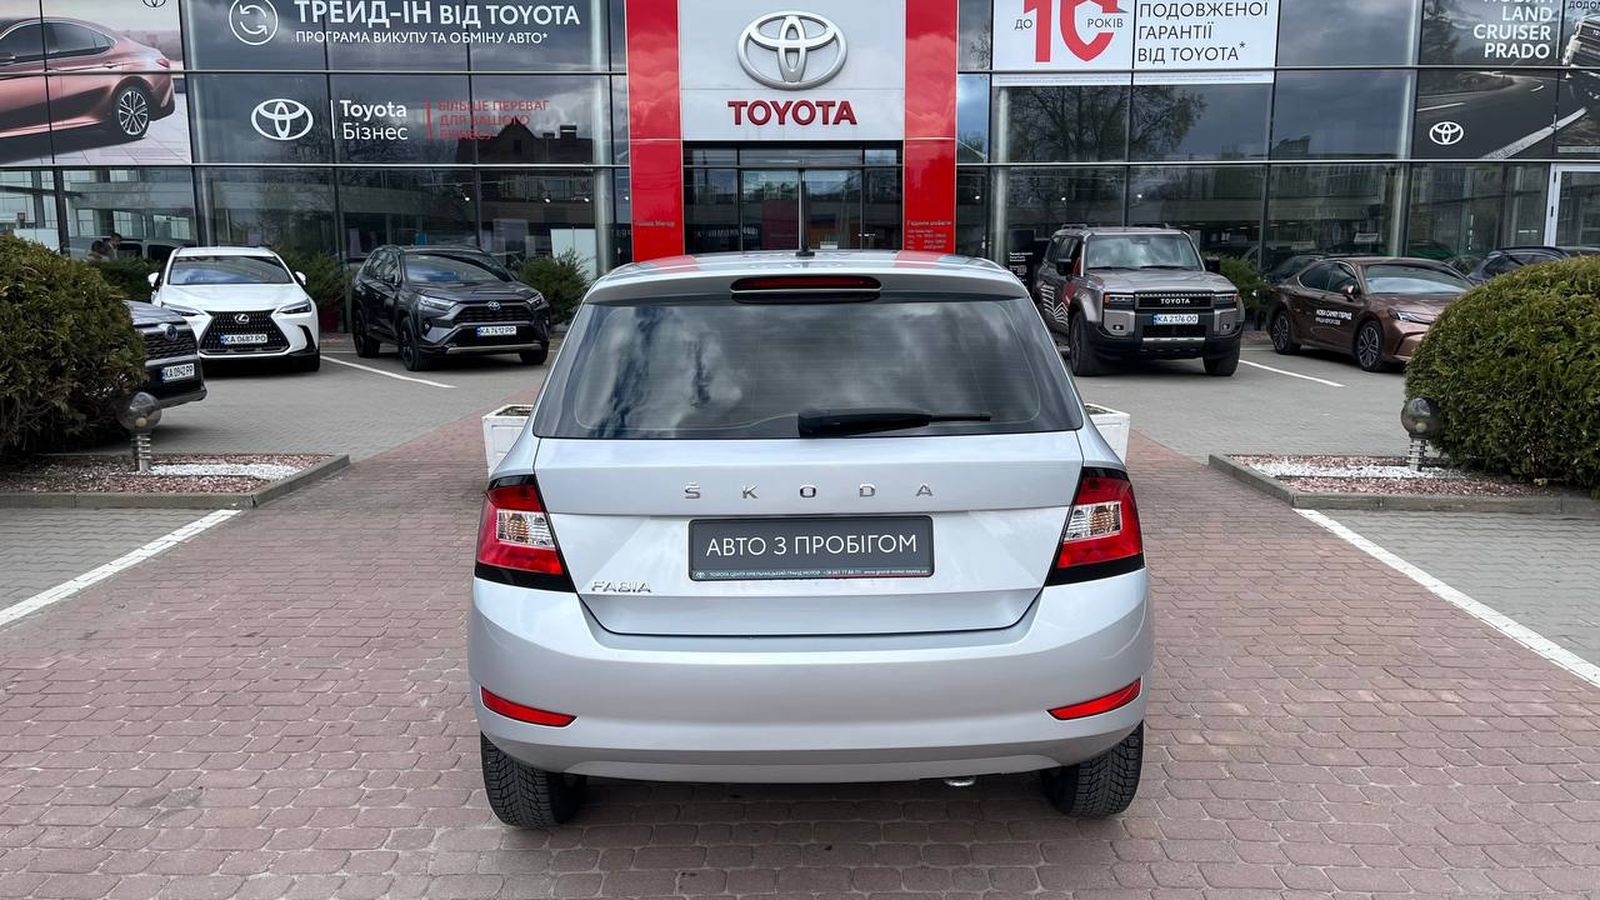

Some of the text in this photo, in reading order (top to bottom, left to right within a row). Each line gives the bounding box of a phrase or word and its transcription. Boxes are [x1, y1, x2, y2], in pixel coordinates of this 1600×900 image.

[440, 6, 481, 28] ВІД
[488, 5, 580, 25] TOYOTA
[1502, 6, 1552, 21] LAND
[1014, 19, 1033, 31] ДО
[1087, 18, 1124, 29] РОКІВ
[1138, 21, 1214, 40] ГАРАНТІЇ
[1473, 24, 1551, 40] CRUISER
[296, 31, 370, 44] ПРОГРАМА
[373, 32, 429, 44] ВИКУПУ
[431, 32, 447, 43] ТА
[450, 32, 504, 44] ОБМІНУ
[1137, 47, 1166, 64] ВІД
[1484, 42, 1550, 59] PRADO
[339, 100, 407, 121] Toyota
[728, 100, 857, 126] TOYOTA
[343, 123, 408, 140] Бізнес
[684, 481, 933, 499] ŠKODA
[705, 536, 767, 557] АВТО
[795, 534, 917, 555] ПРОБІГОМ
[591, 580, 651, 593] FABIA
